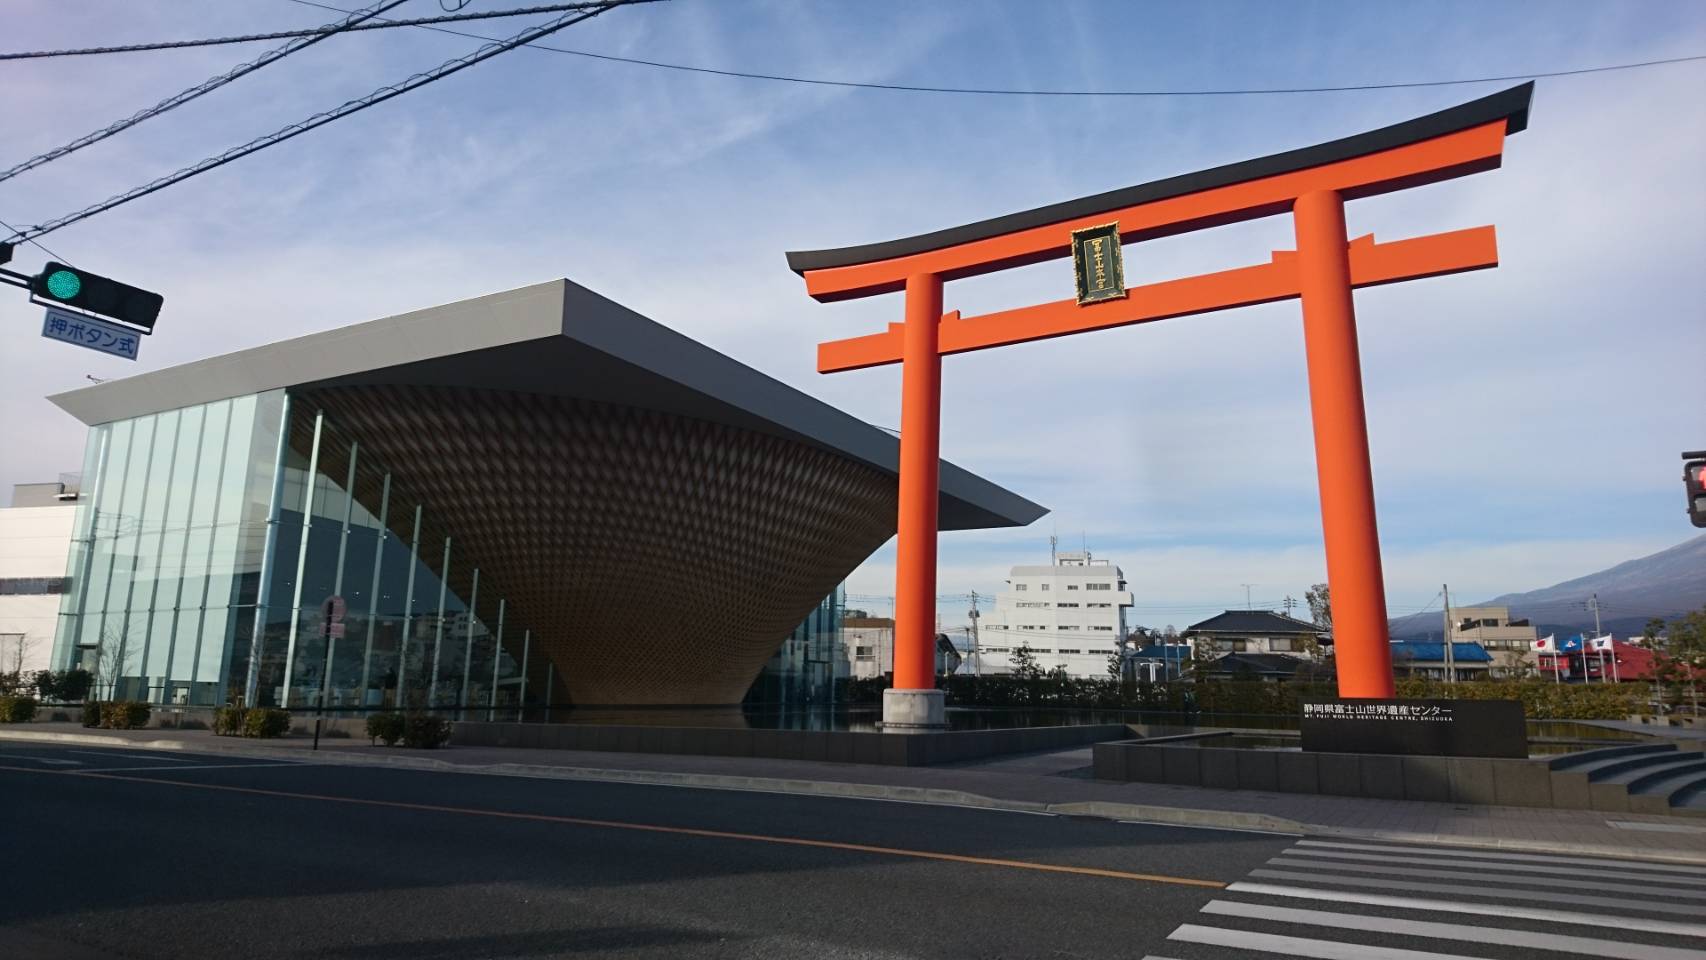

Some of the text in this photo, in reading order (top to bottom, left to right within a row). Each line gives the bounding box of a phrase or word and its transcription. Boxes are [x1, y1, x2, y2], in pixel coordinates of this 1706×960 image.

[49, 316, 135, 354] 押ボタン式
[1303, 703, 1452, 716] 静岡県富士山世界遺産センター
